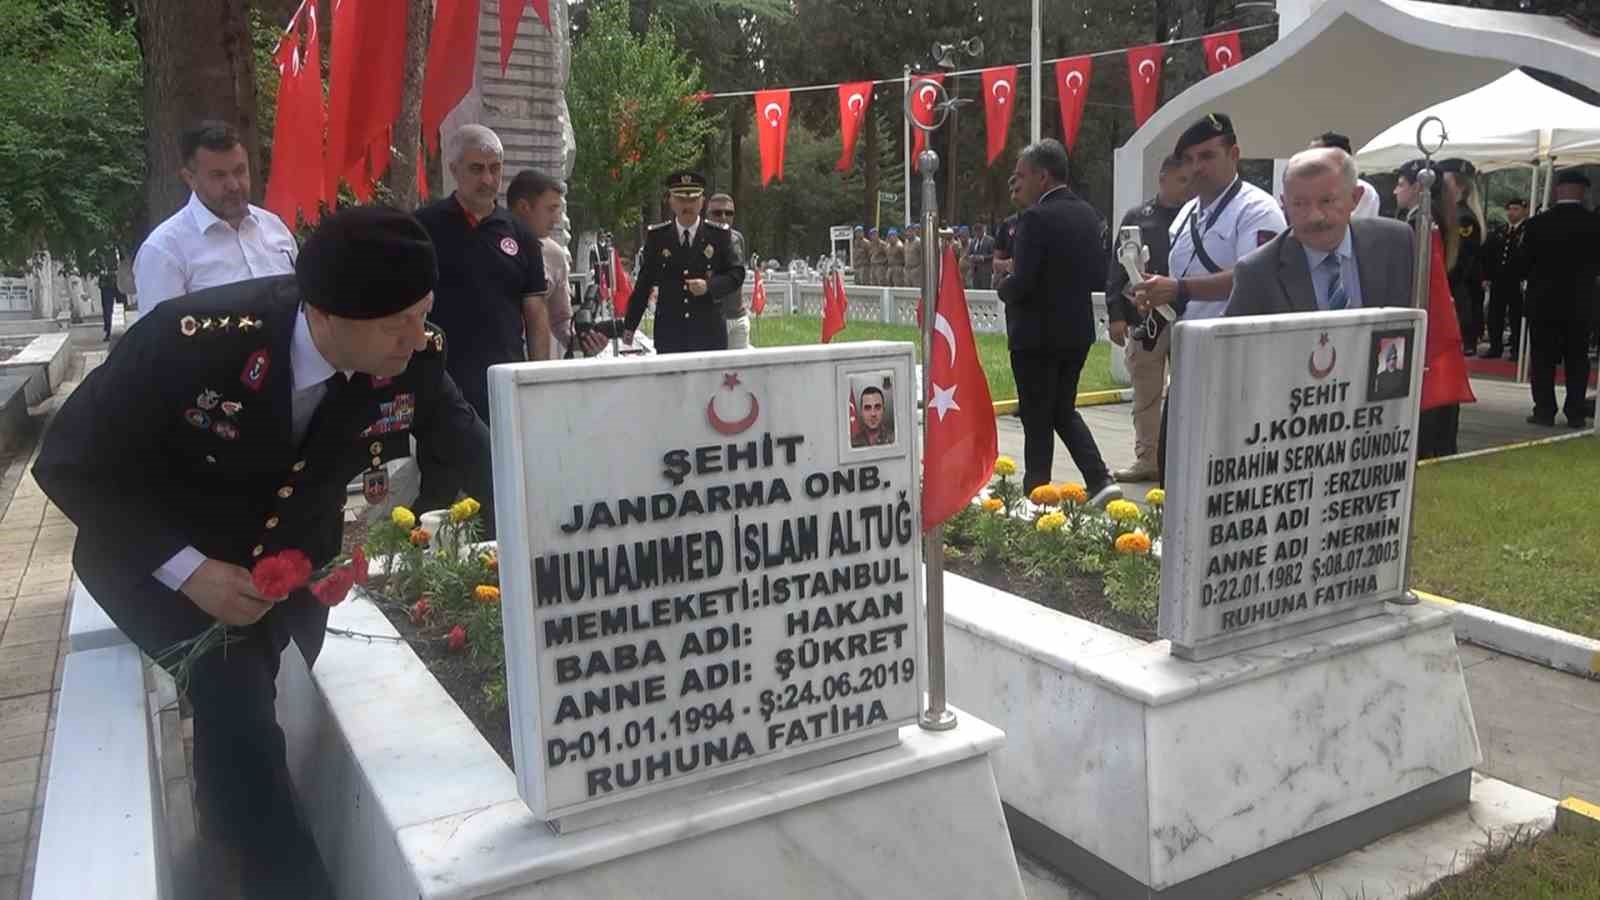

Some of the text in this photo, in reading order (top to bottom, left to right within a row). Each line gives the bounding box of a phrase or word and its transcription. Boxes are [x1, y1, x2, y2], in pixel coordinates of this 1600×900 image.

[1290, 378, 1350, 414] ŞEHİT
[663, 432, 804, 486] ŞEHİT
[1207, 425, 1410, 487] İBRAHİM SERKAN GÜNDÜZ
[561, 466, 891, 534] JANDARMA ONB.
[1208, 472, 1313, 518] MEMLEKETİ
[534, 490, 912, 607] MUHAMMED İSLAM ALTUĞ
[1207, 545, 1267, 577] ANNE
[1274, 536, 1308, 562] ADI
[1210, 515, 1268, 547] BABA
[1275, 507, 1309, 533] ADI
[1202, 562, 1303, 608] D:22.01.1982
[1223, 573, 1378, 629] RUHUNA FATİHA
[556, 591, 903, 684] BABA ADI: HAKAN
[554, 623, 908, 725] ANNE ADI: ŞÜKRET
[759, 658, 915, 722] Ş:24.06.2019
[586, 699, 888, 796] RUHUNA FATİHA
